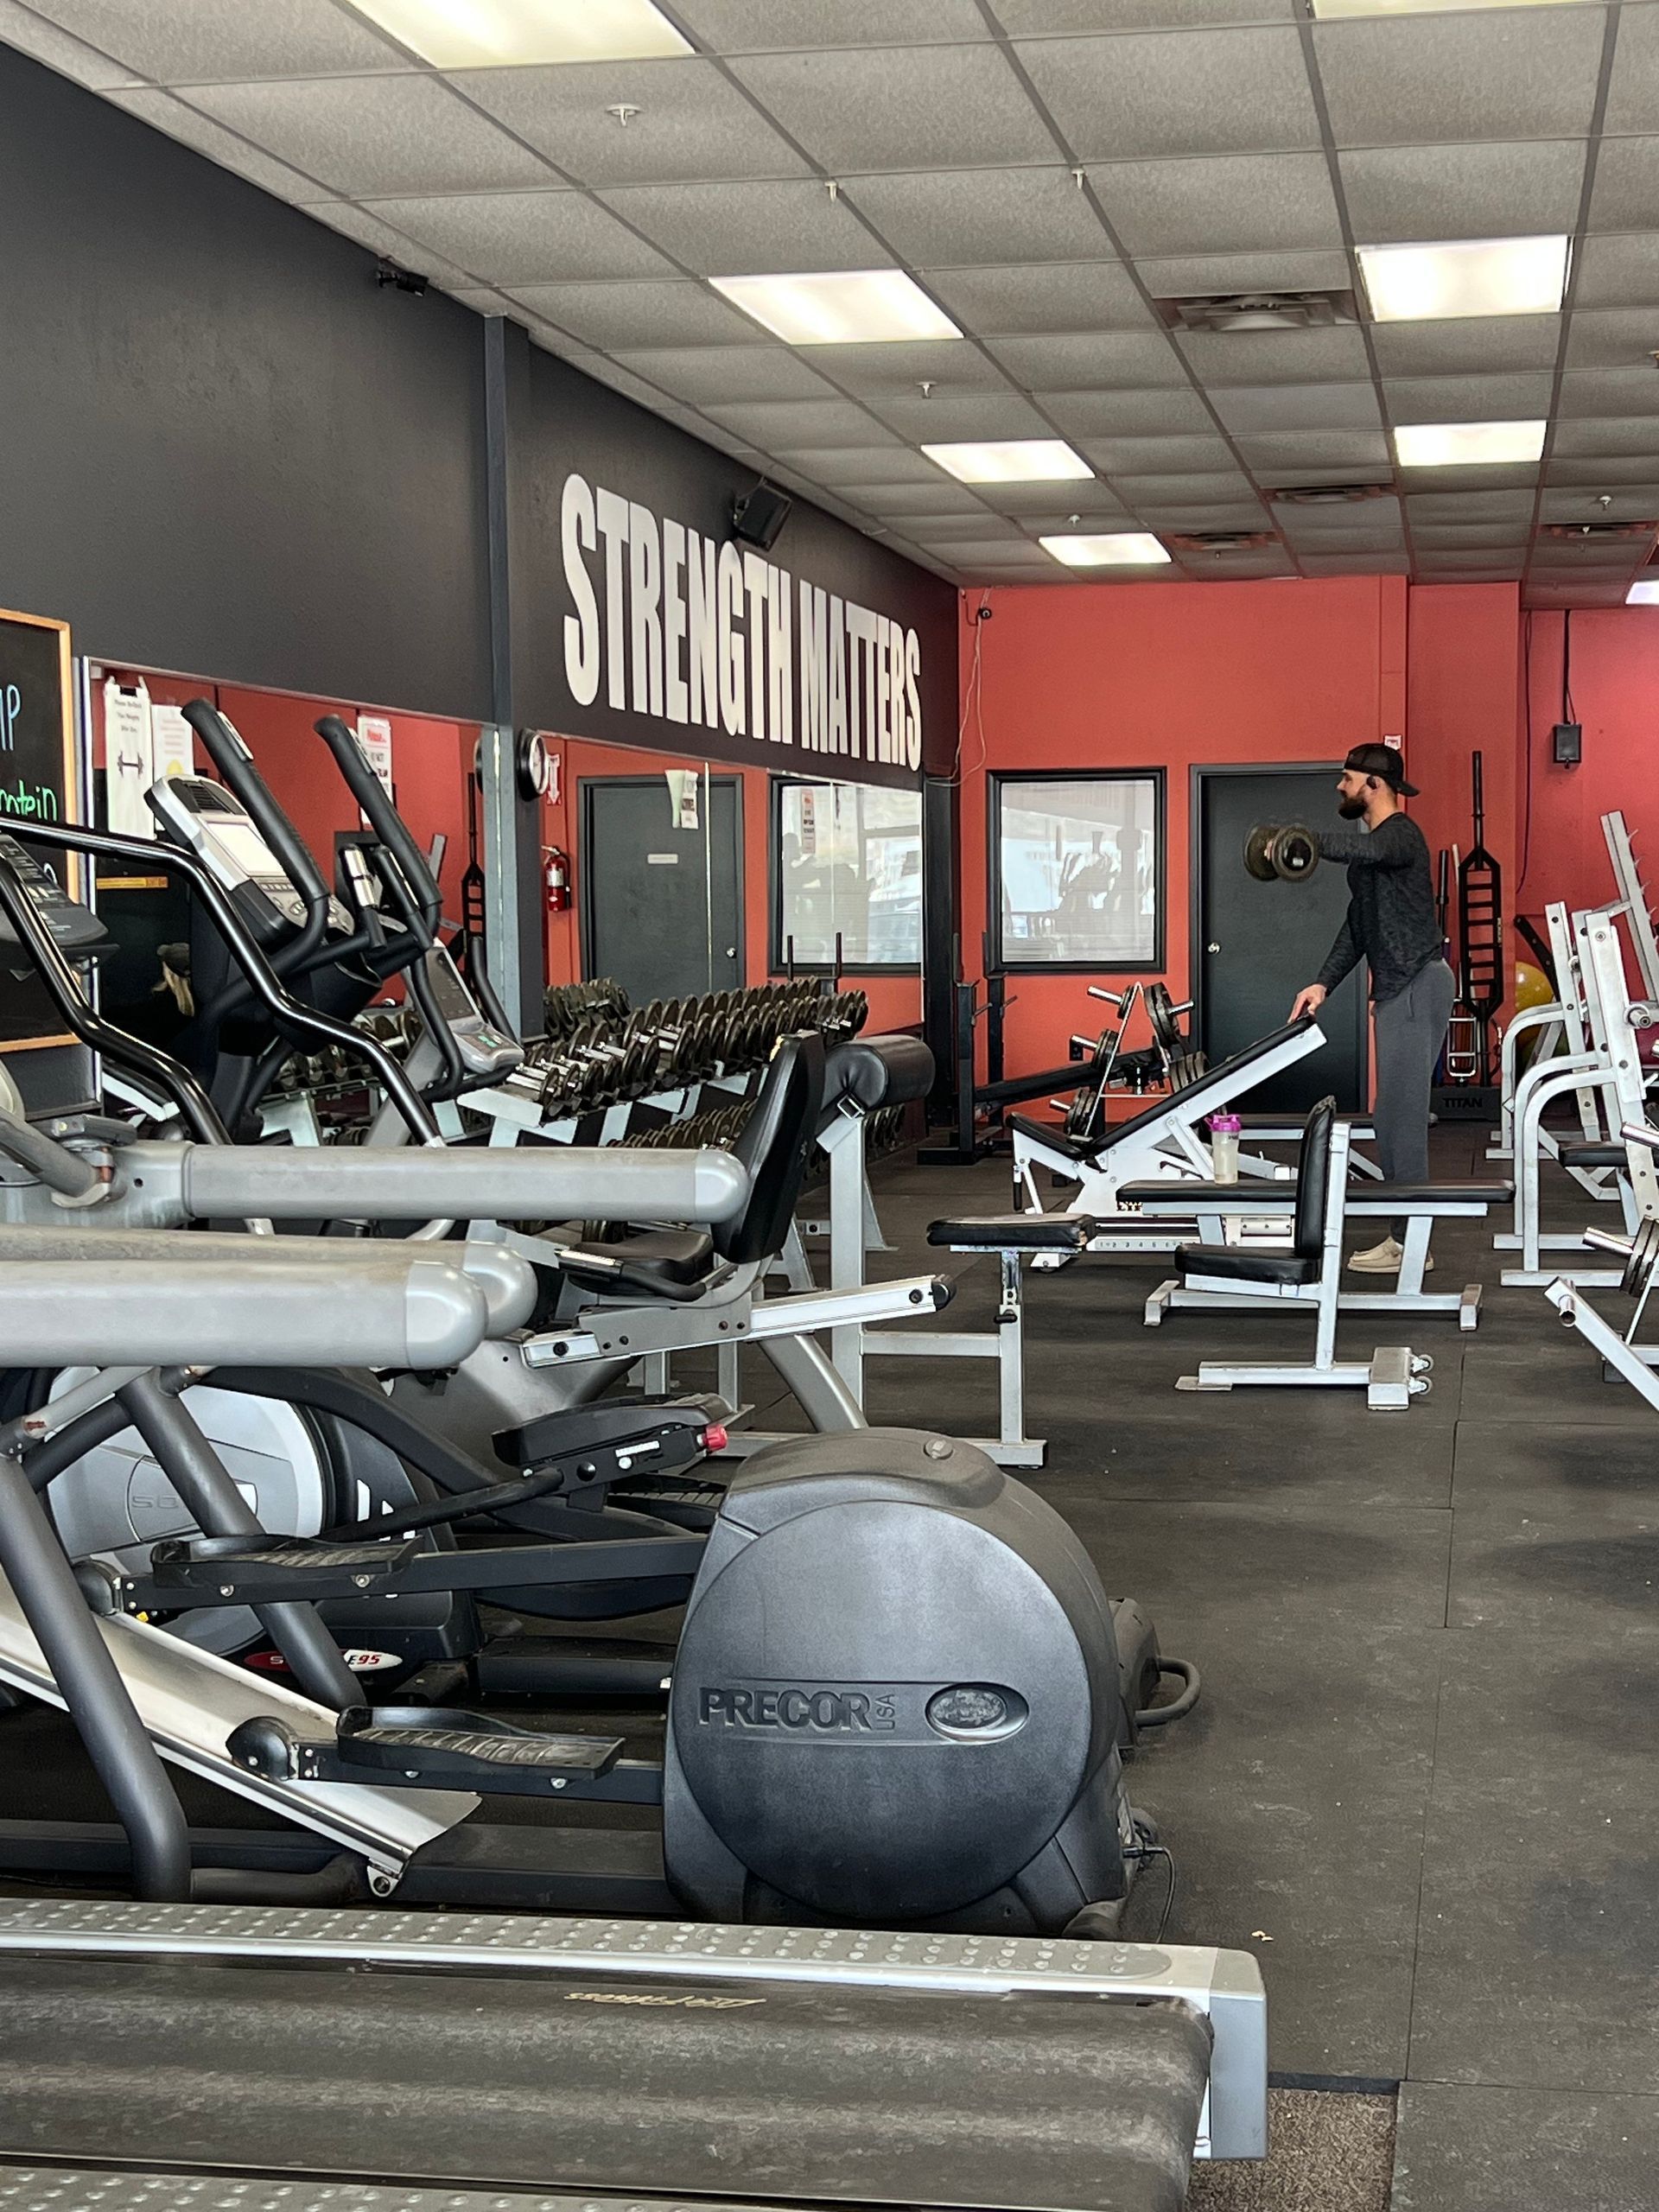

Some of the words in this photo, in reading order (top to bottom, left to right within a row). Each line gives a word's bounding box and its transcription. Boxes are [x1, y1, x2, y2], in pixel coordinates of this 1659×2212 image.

[561, 474, 793, 744] STRENGTH
[799, 579, 922, 772] MATTERS
[1441, 1097, 1484, 1109] TITAN
[131, 1496, 179, 1510] SO
[347, 1654, 382, 1665] E95
[699, 1687, 872, 1732] PRECOR
[875, 1694, 896, 1731] USA
